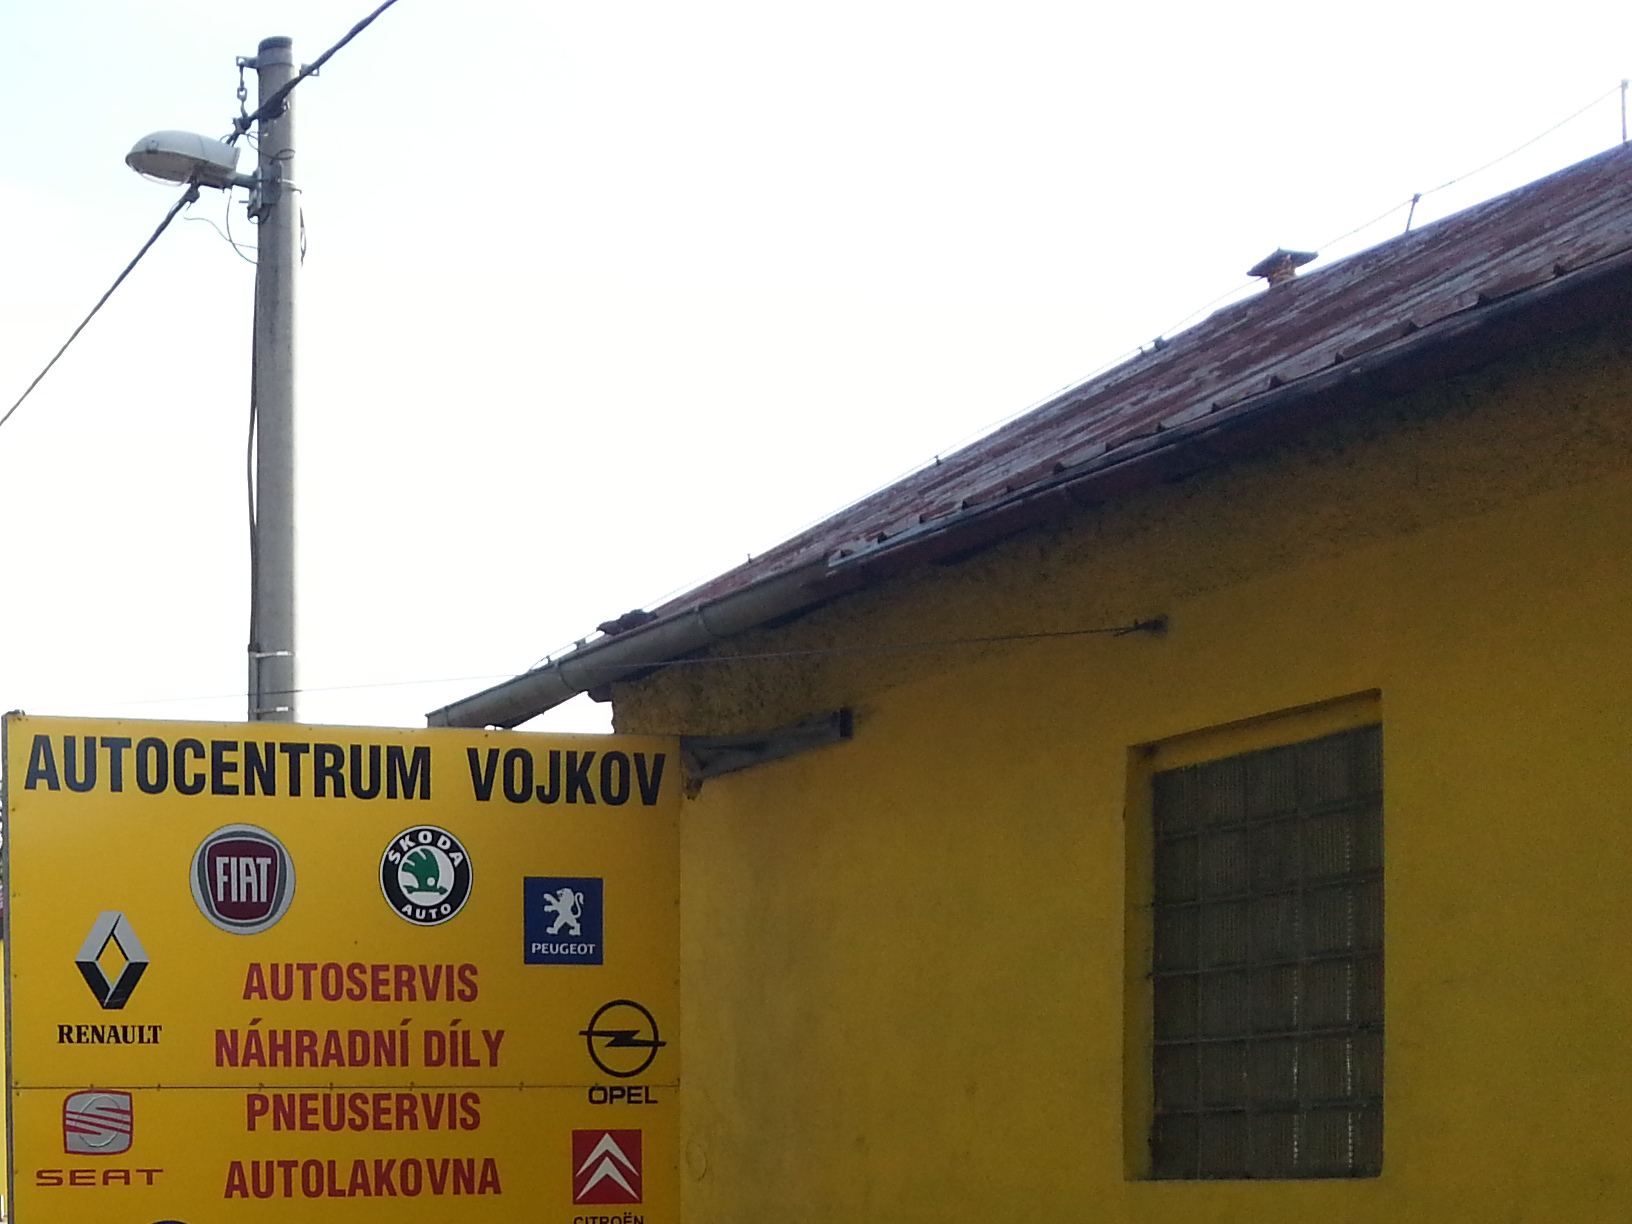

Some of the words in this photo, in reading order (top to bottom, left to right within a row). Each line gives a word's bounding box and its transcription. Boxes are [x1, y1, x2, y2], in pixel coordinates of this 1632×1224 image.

[24, 733, 432, 801] AUTOCENTRUM
[467, 746, 667, 807] VOJKOV
[387, 829, 465, 869] ŠKODA
[215, 855, 272, 904] FIAT
[401, 901, 453, 921] AUTO
[530, 942, 596, 956] PEUGEOT
[242, 961, 480, 1003] AUTOSERVIS
[56, 1023, 163, 1046] RENAULT
[214, 1017, 410, 1069] NÁHRADNÍ
[424, 1018, 506, 1068] DÍLY
[246, 1091, 482, 1133] PNEUSERVIS
[588, 1085, 659, 1105] OPEL
[35, 1168, 164, 1187] SEAT
[223, 1157, 503, 1200] AUTOLAKOVNA
